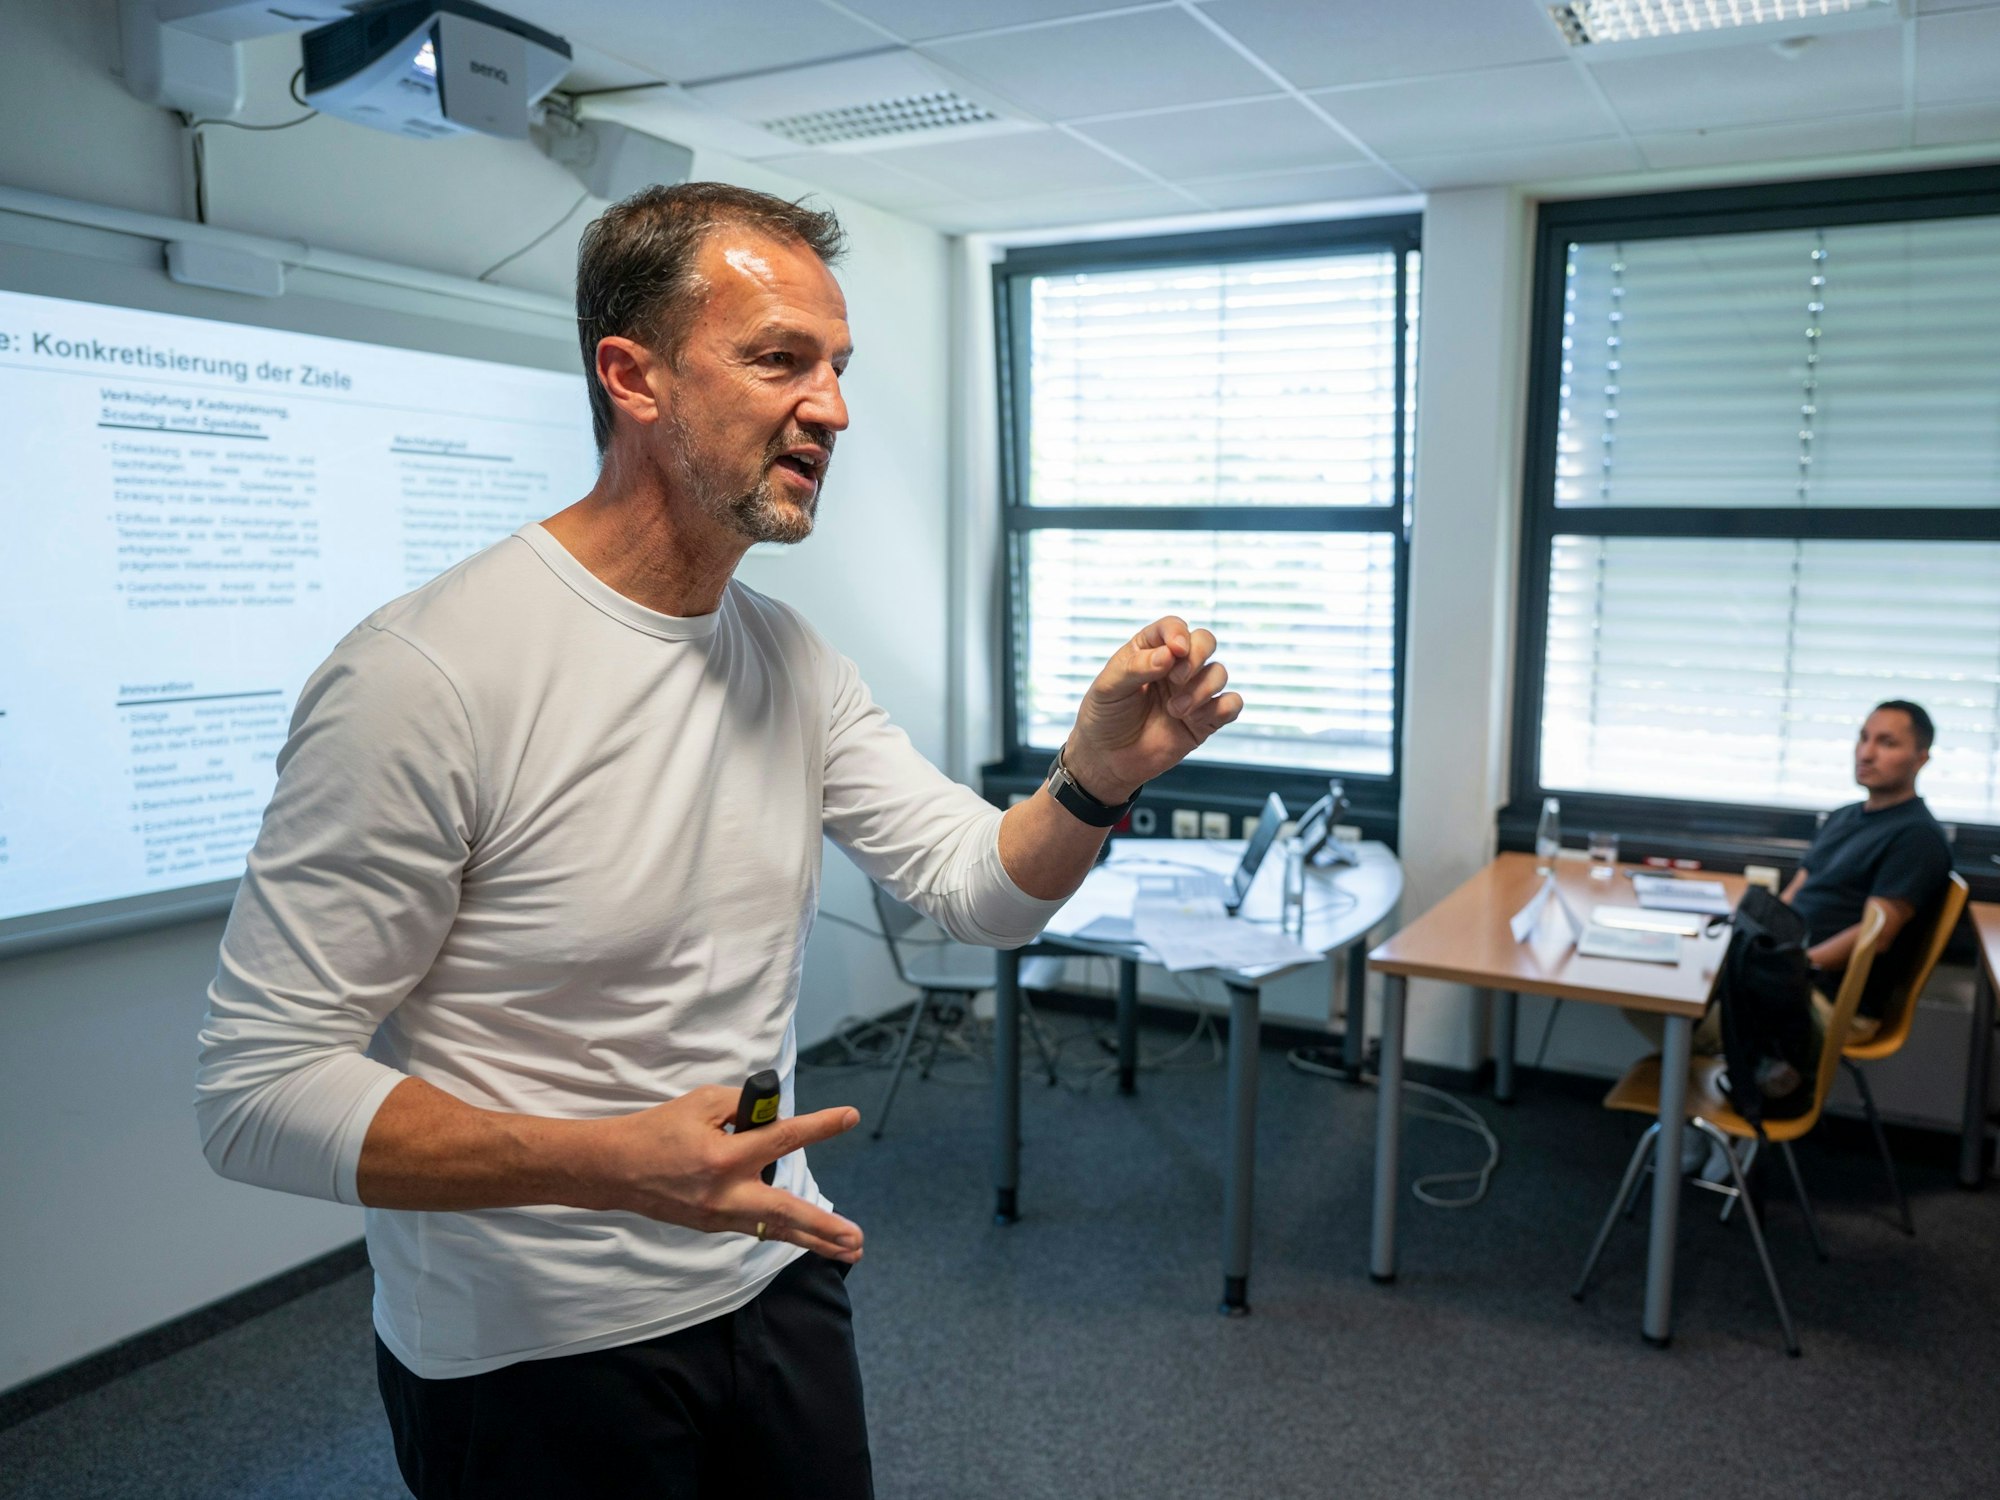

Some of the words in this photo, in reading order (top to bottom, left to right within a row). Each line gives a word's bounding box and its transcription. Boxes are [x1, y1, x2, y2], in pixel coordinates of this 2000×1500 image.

[33, 331, 249, 382] Konkretisierung
[256, 359, 293, 383] der
[300, 365, 352, 391] Ziele
[100, 387, 192, 410] Verknüpfung
[102, 407, 166, 428] Scouting
[170, 415, 197, 426] und
